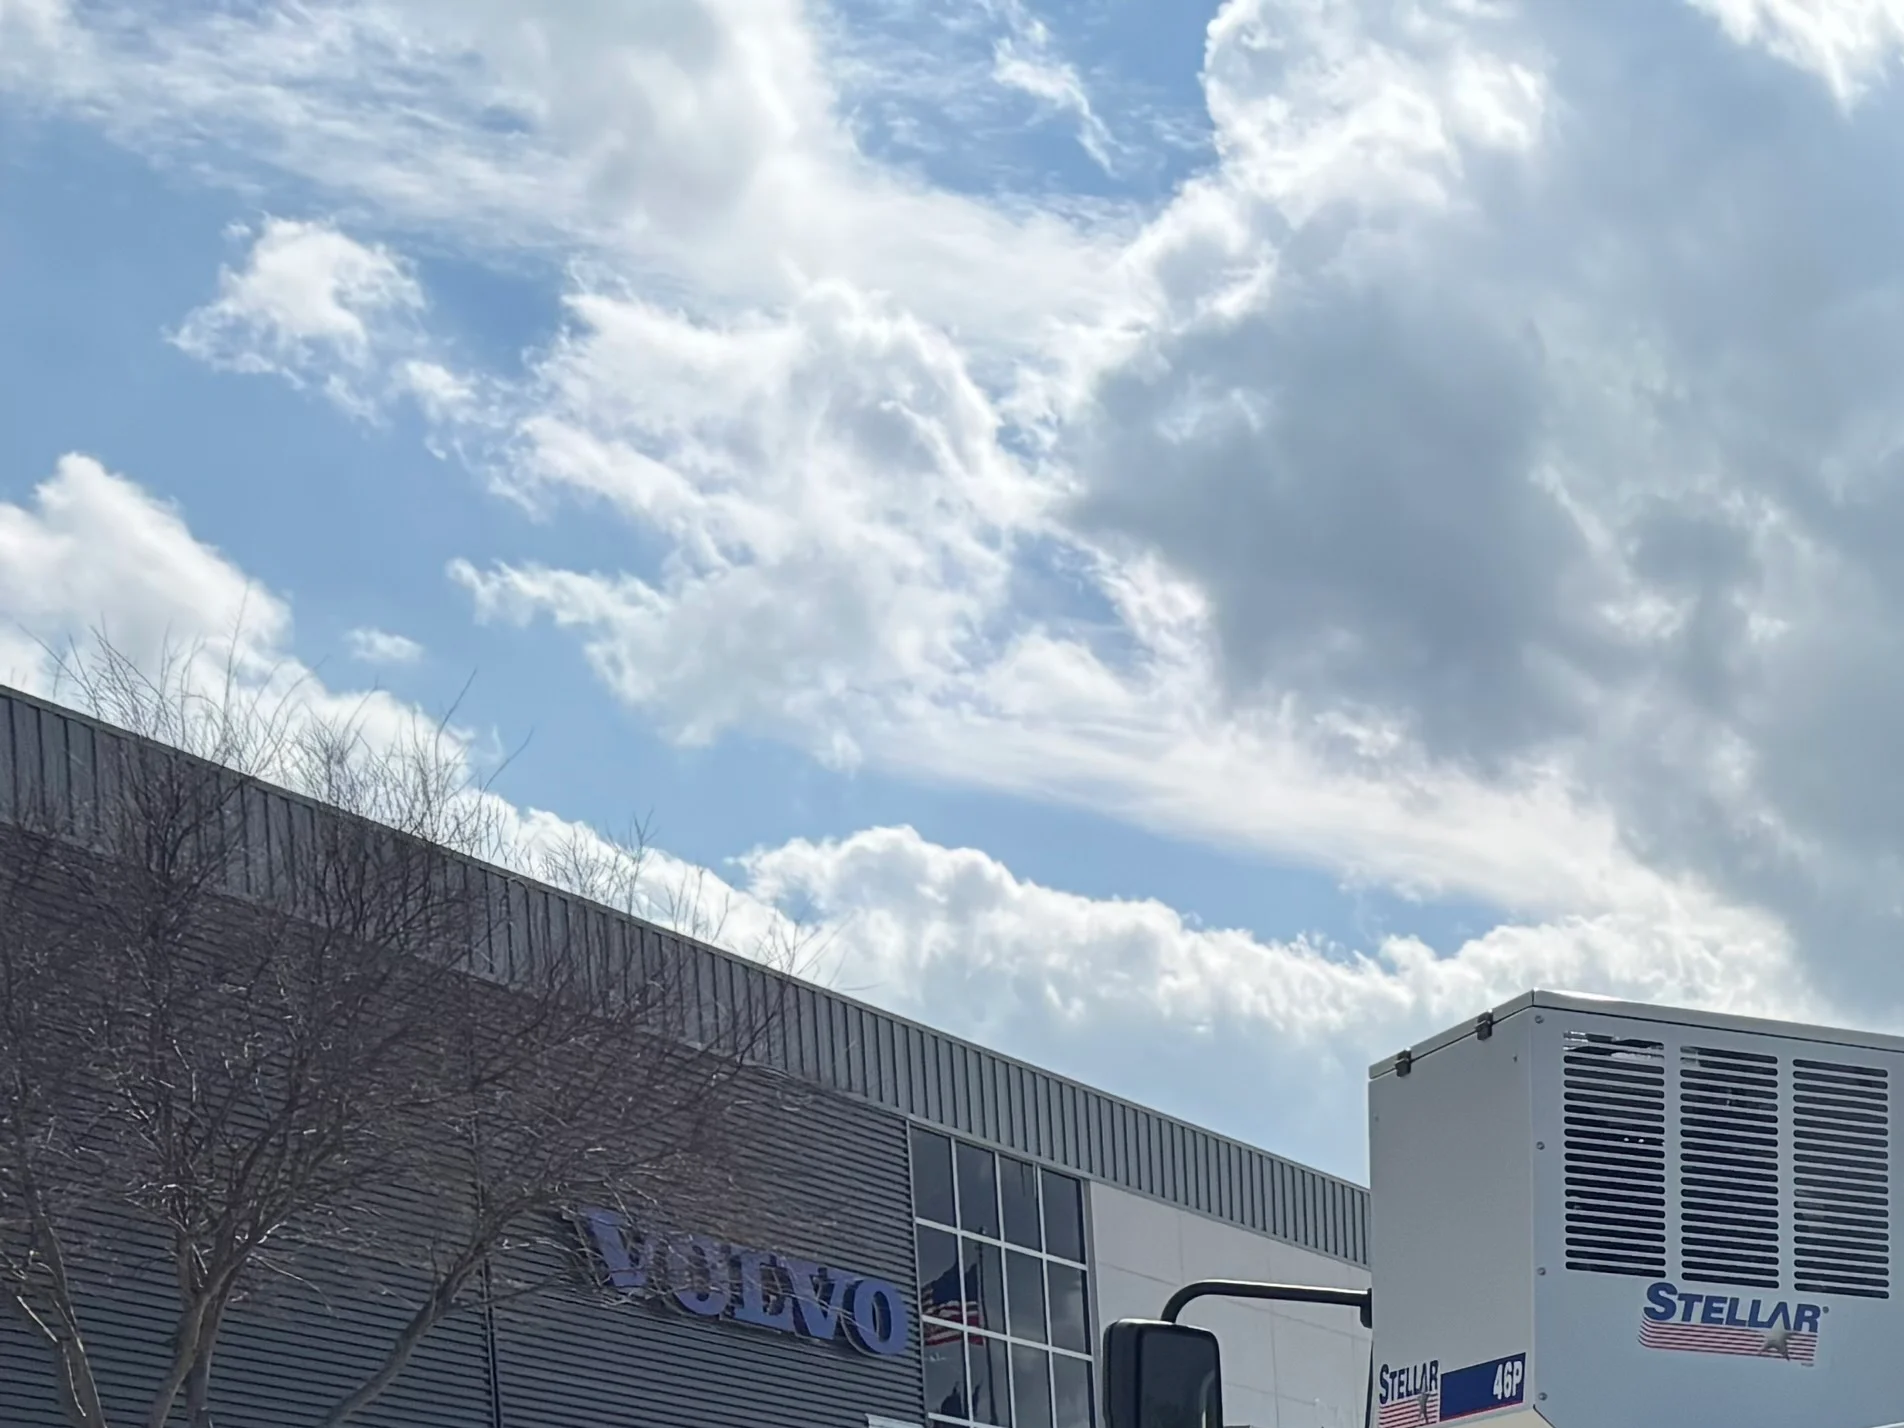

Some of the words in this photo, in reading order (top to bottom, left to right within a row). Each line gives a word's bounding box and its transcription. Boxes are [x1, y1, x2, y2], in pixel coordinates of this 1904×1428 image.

[566, 1206, 910, 1357] VOLVO
[1643, 1281, 1822, 1333] STELLAR
[1378, 1359, 1439, 1405] STELLAR
[1492, 1360, 1523, 1401] 46P
